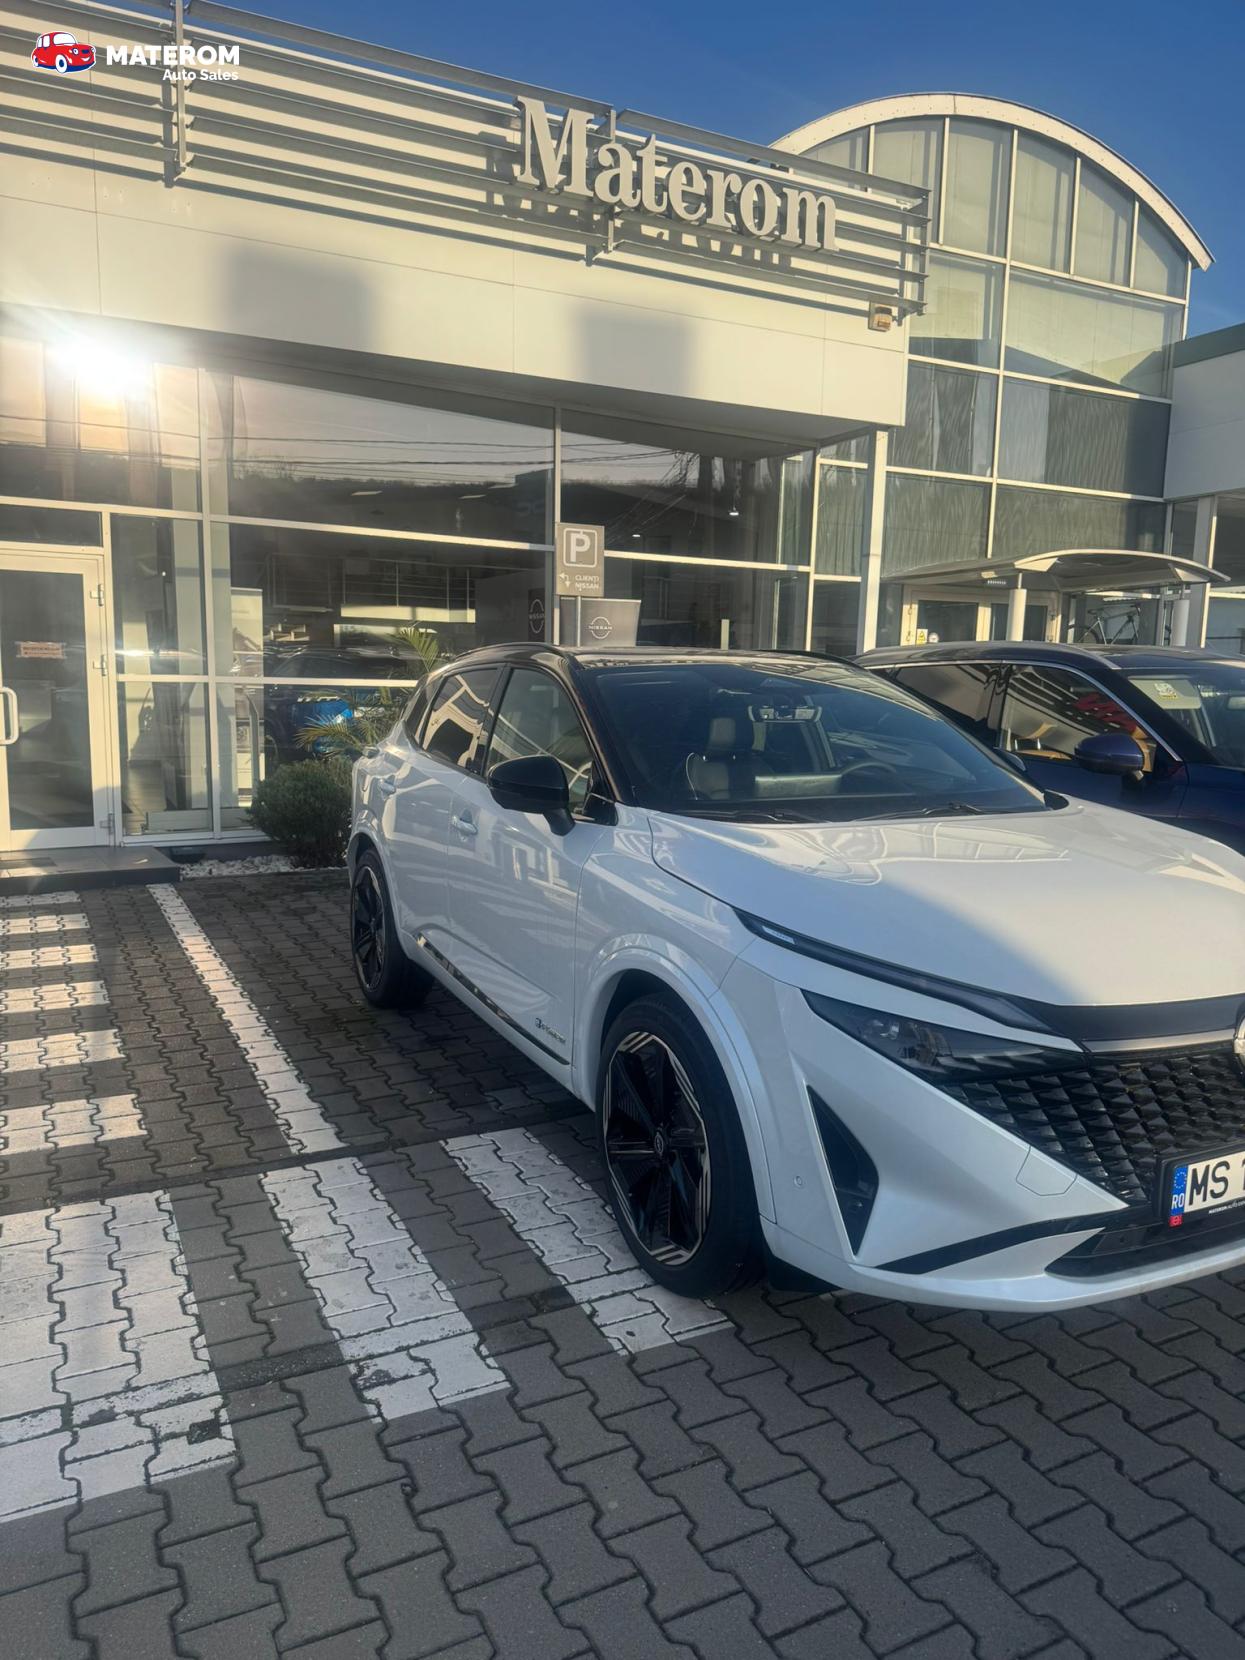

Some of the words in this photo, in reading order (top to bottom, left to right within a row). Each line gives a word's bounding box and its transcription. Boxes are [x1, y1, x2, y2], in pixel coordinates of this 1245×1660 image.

[514, 95, 838, 252] Materom
[569, 532, 591, 563] P
[1171, 1192, 1185, 1210] RO
[1188, 1160, 1231, 1206] MS
